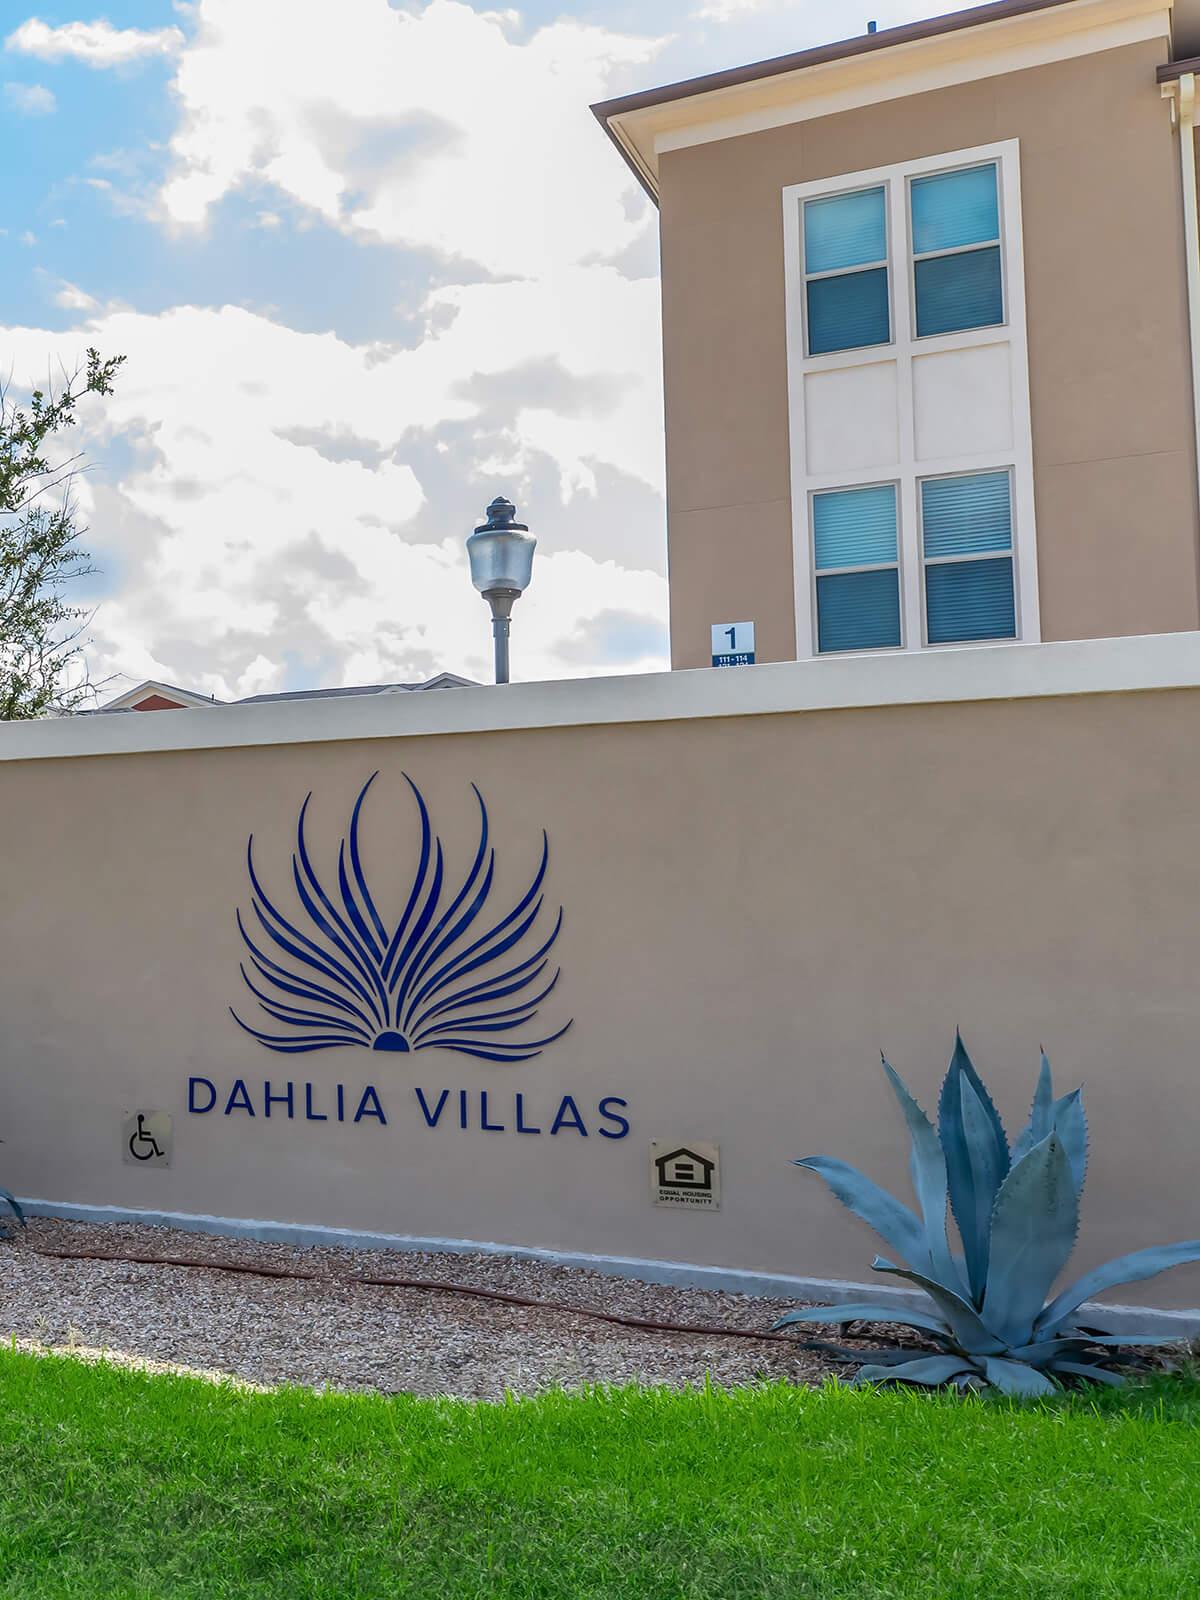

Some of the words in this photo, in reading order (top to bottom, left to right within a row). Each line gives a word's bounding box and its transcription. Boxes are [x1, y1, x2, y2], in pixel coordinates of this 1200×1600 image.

[725, 627, 736, 650] 1
[187, 1076, 388, 1125] DAHLIA
[415, 1087, 630, 1140] VILLAS
[659, 1189, 681, 1197] EQUAL
[682, 1191, 712, 1199] HOUSING
[659, 1195, 712, 1205] OPPORTUNITY
